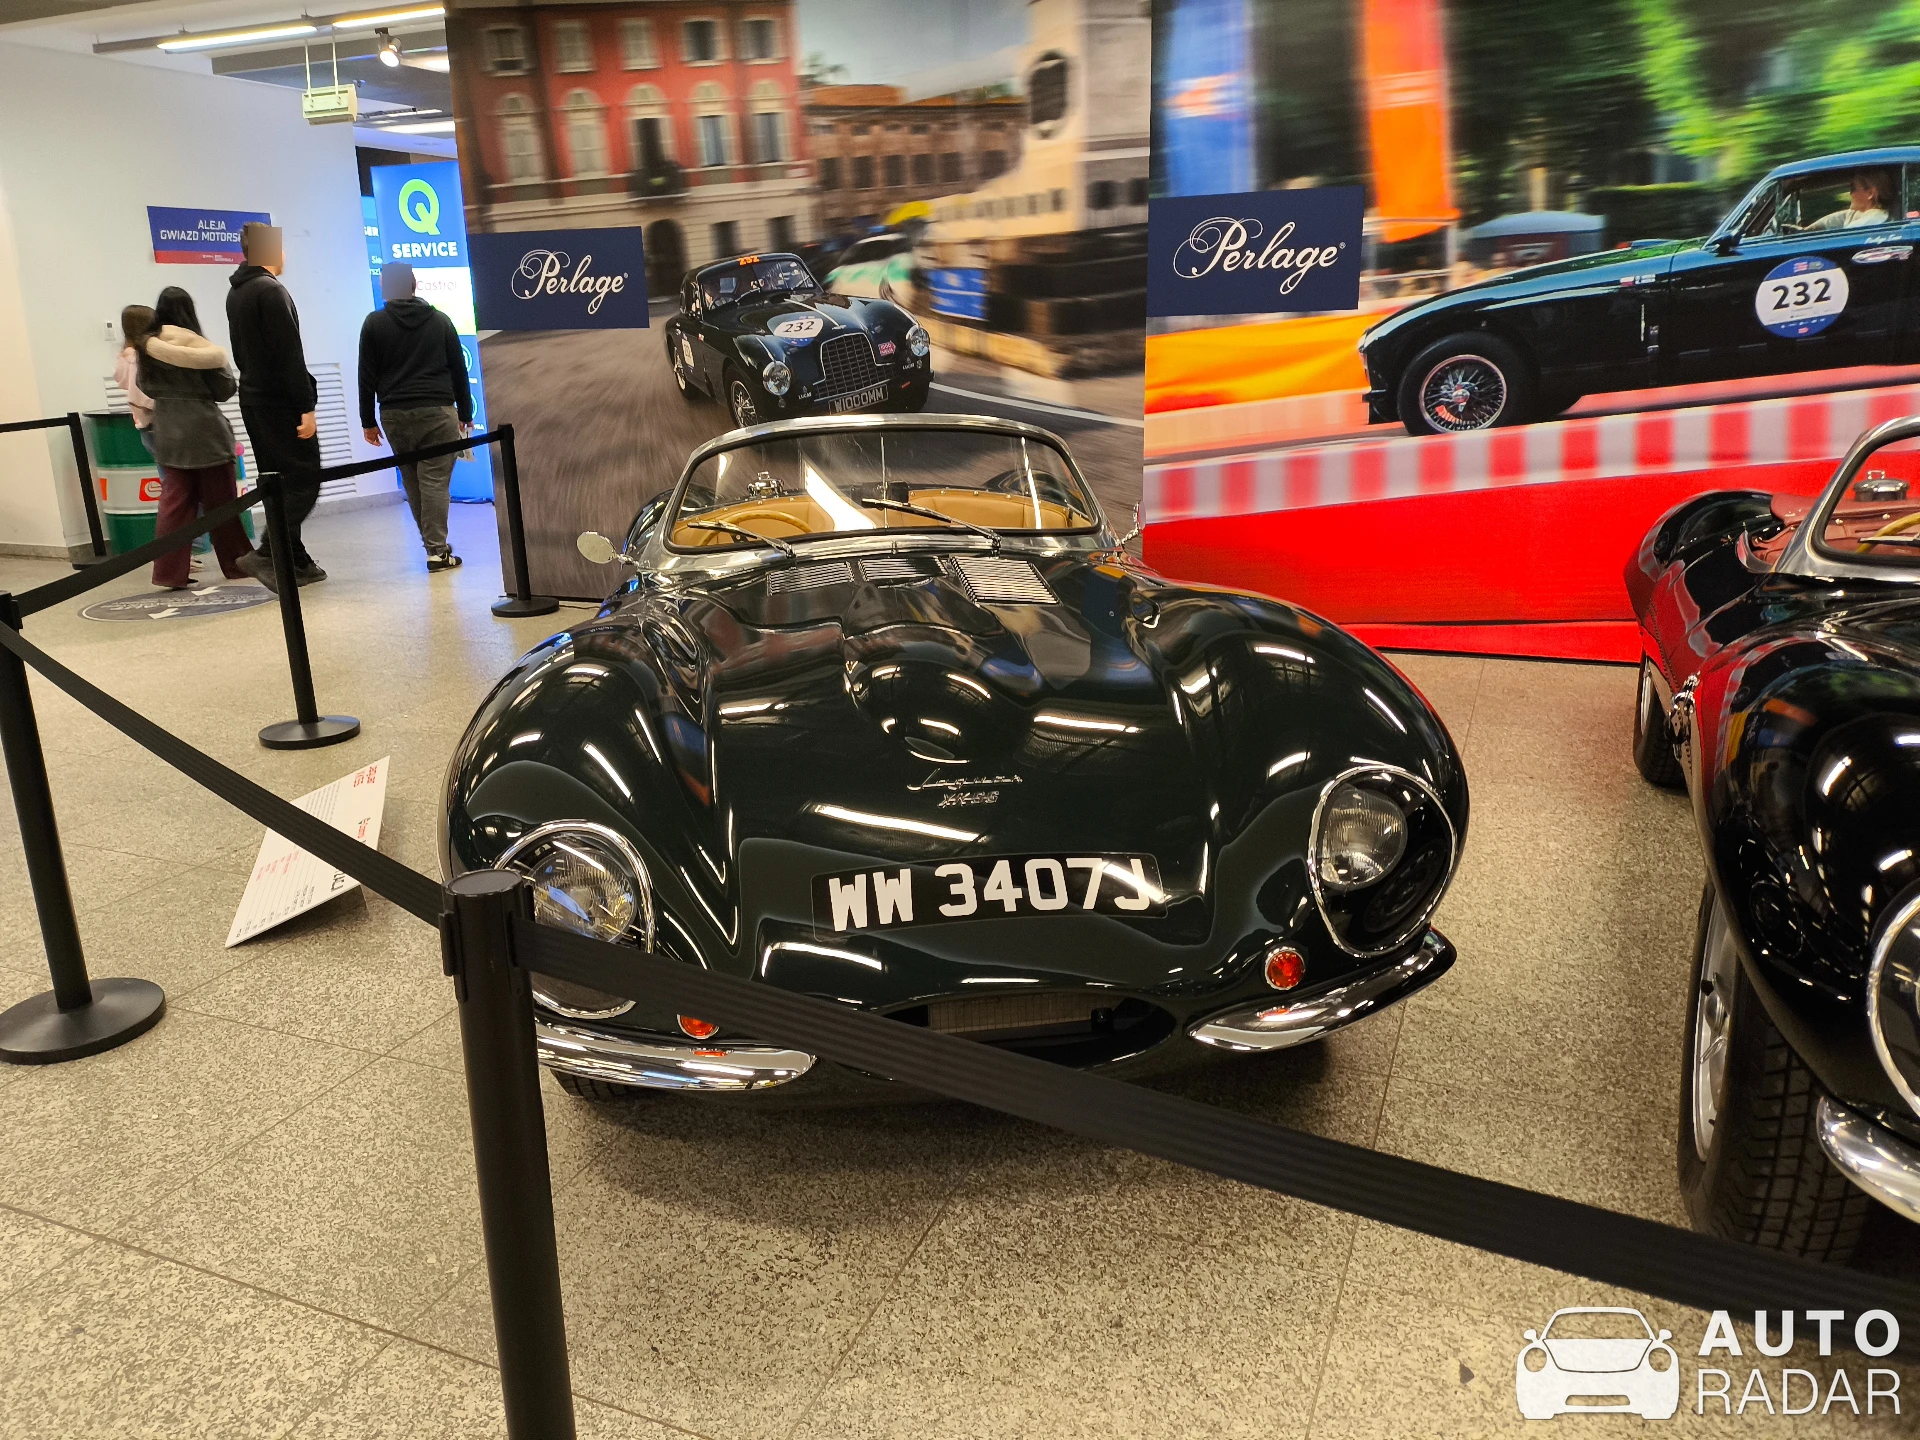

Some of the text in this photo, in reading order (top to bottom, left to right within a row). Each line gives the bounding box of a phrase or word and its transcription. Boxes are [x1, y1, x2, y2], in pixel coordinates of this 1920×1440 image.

[398, 178, 441, 236] Q
[198, 219, 226, 231] ALEJA
[160, 230, 199, 241] GWIAZD
[391, 241, 459, 259] SERVICE
[416, 280, 458, 291] Castrol
[1772, 278, 1832, 311] 232
[783, 320, 815, 333] 232
[829, 858, 1150, 932] WW 3407J
